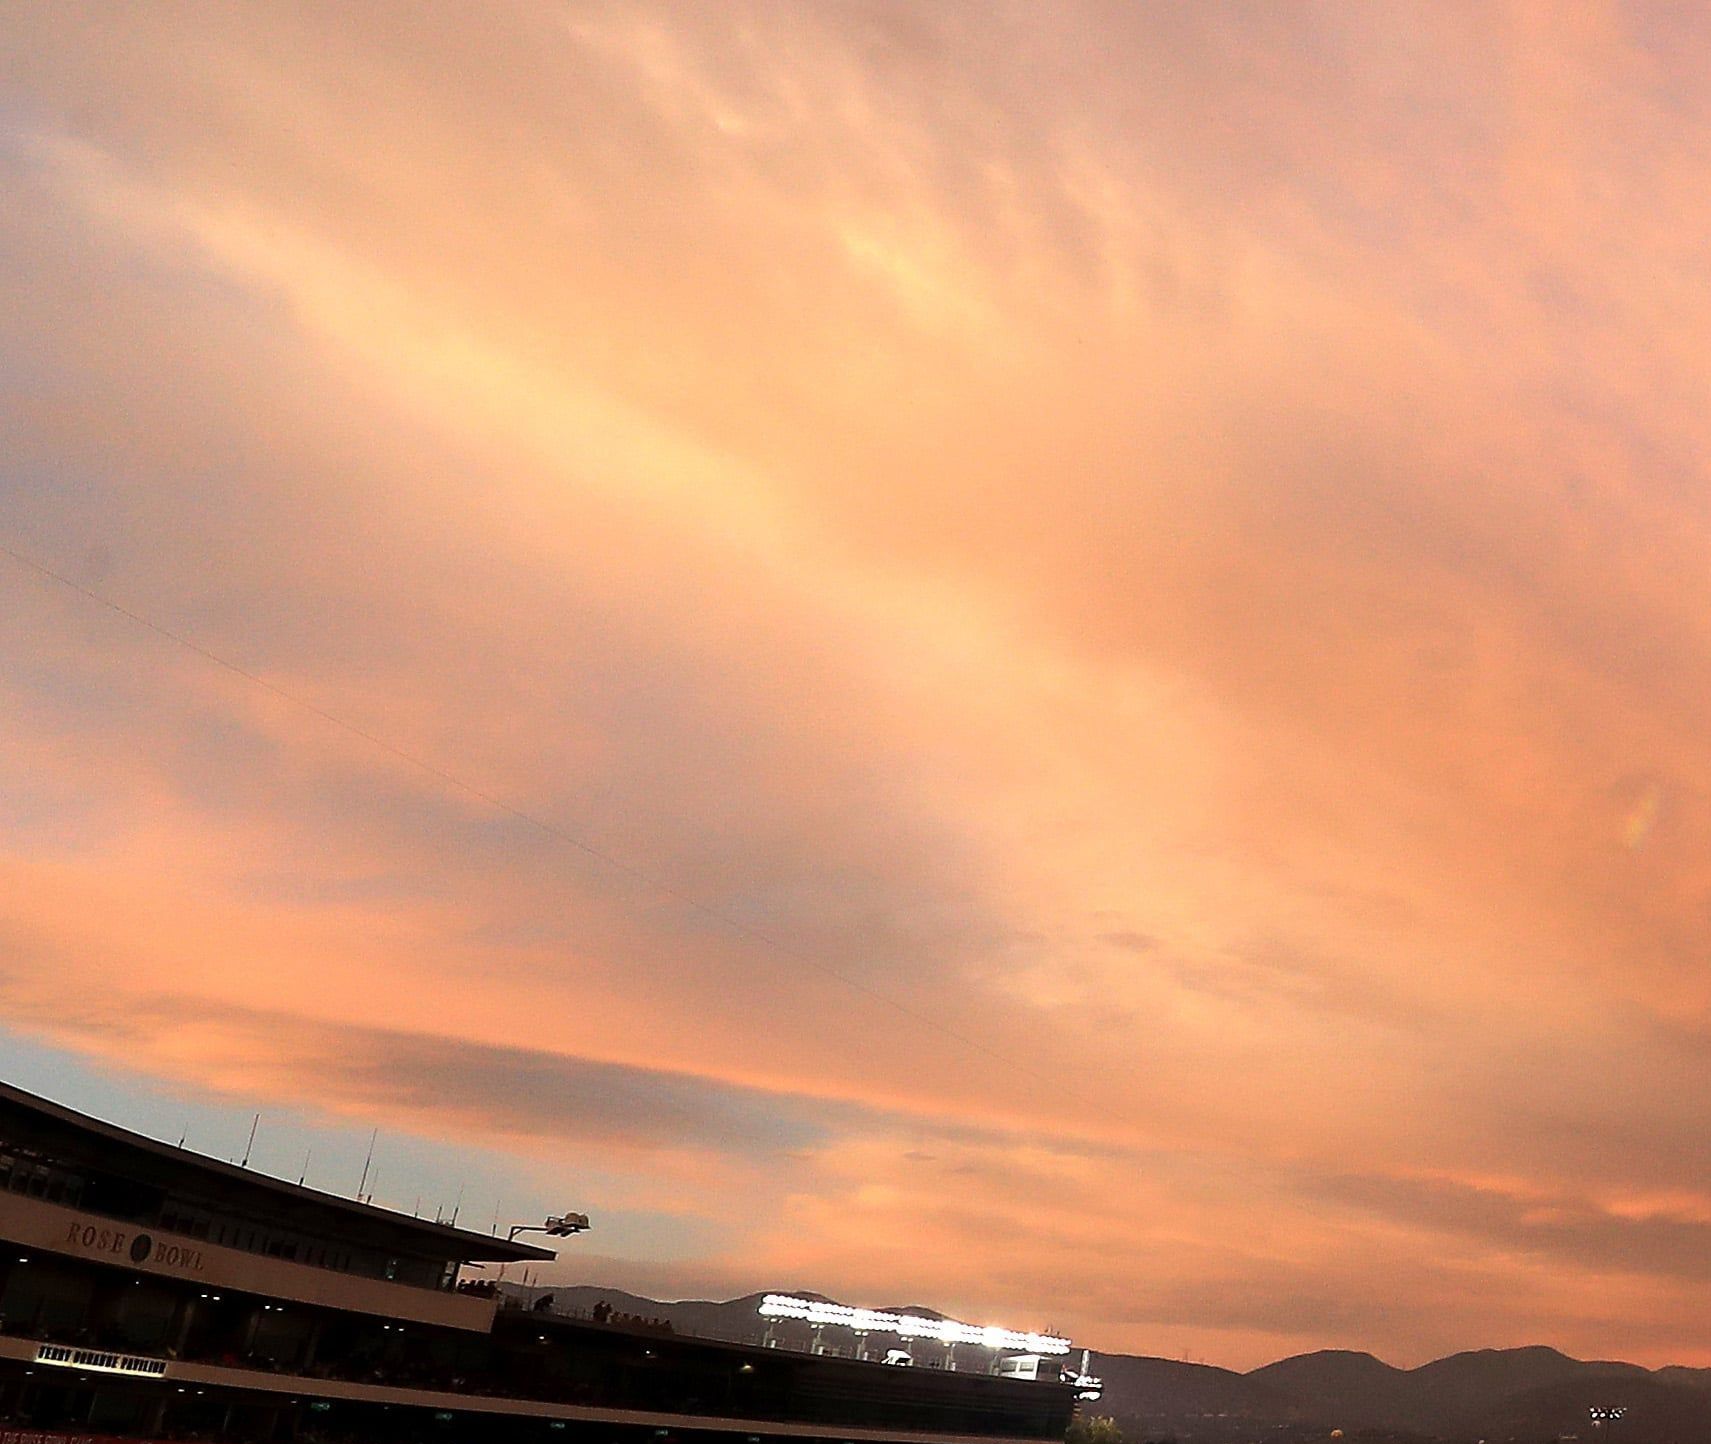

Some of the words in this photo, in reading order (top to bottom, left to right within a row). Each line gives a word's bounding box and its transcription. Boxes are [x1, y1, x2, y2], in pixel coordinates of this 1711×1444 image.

[67, 1222, 125, 1253] ROSE
[155, 1241, 204, 1271] BOWL
[120, 1357, 166, 1375] PAVILION
